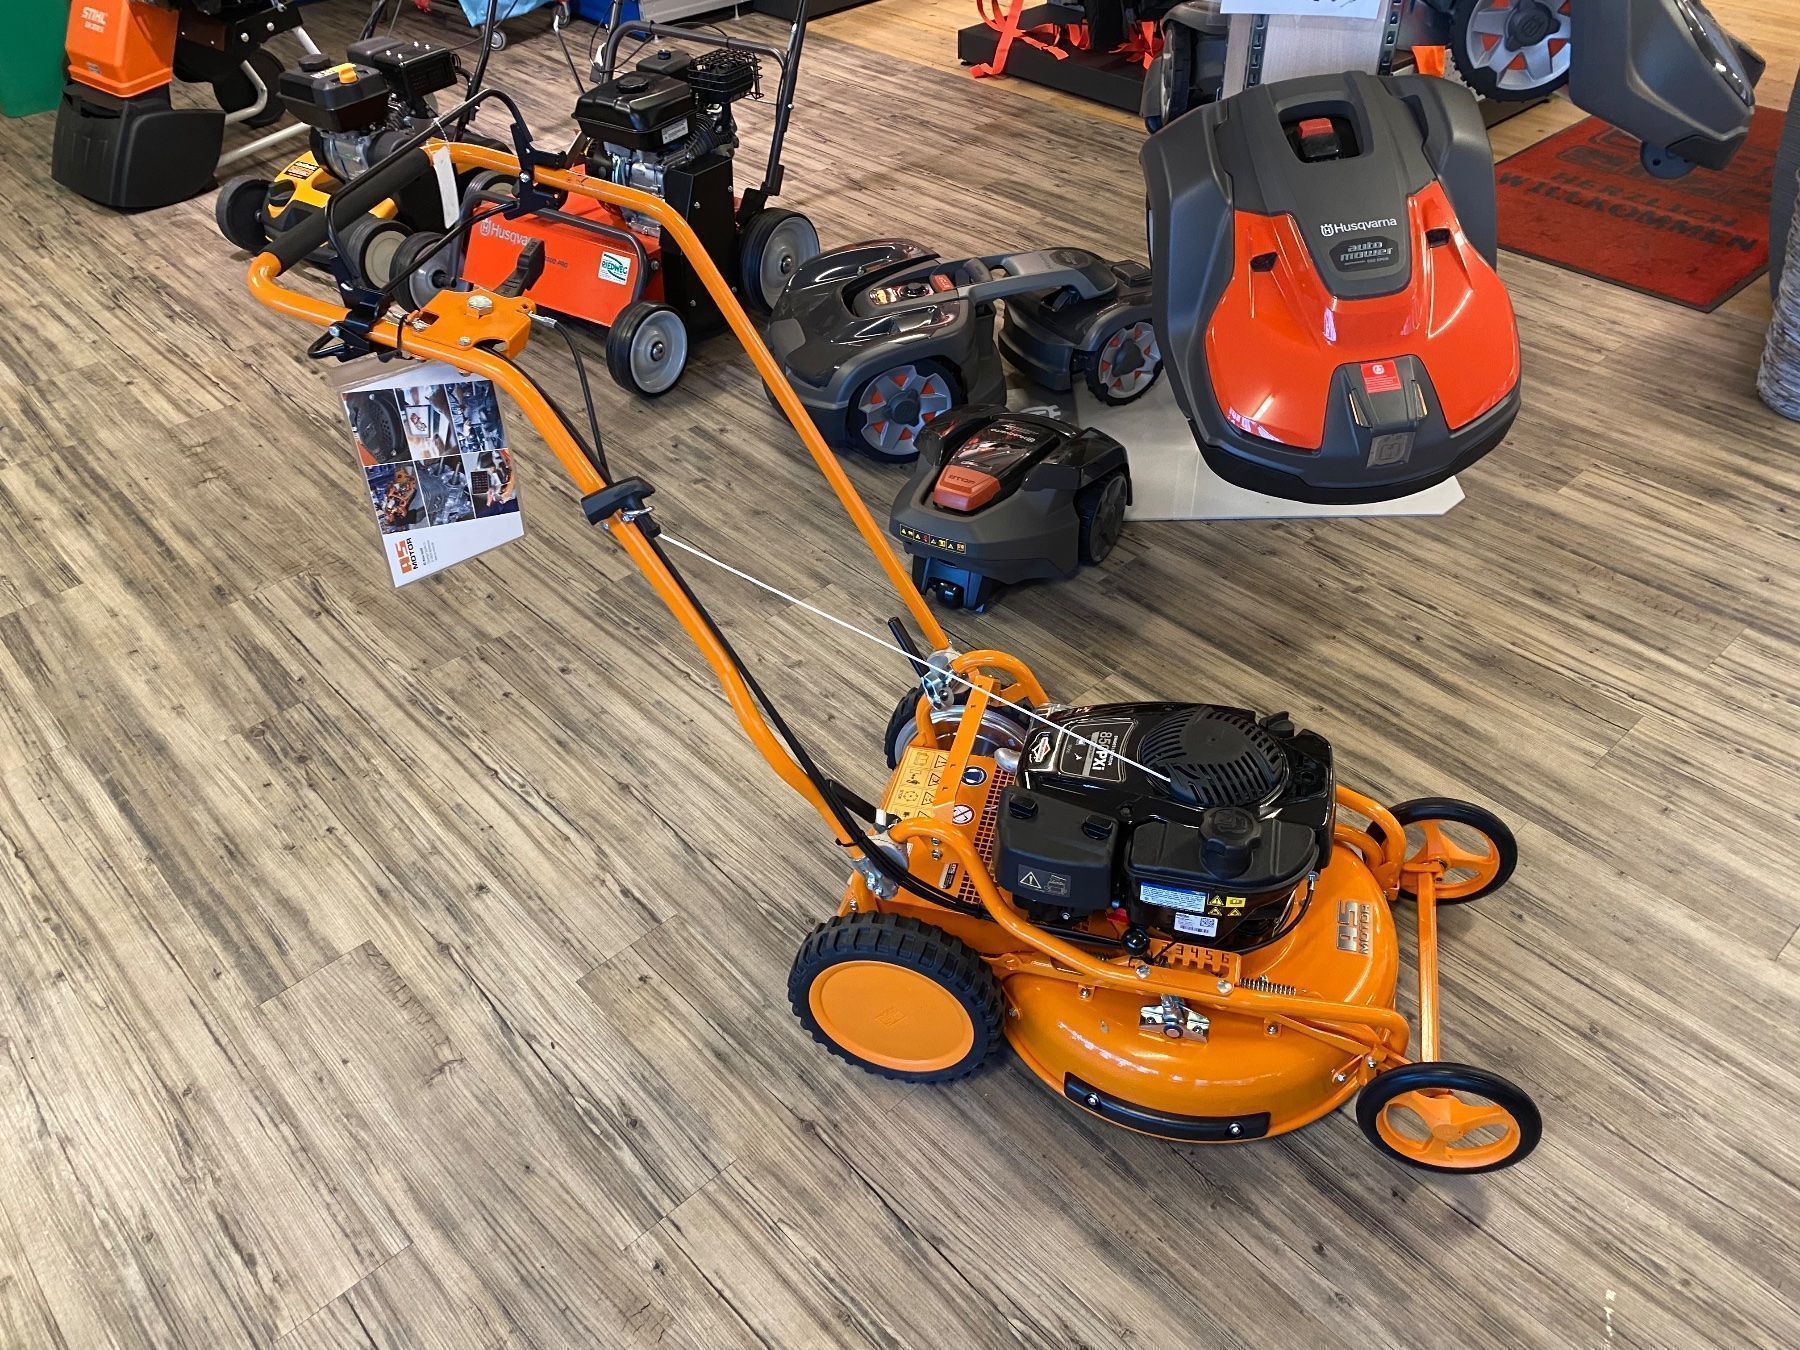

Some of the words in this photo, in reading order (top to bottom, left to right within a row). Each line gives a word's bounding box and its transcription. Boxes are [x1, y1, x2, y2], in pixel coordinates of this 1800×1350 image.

[81, 6, 108, 25] STIHL
[1499, 171, 1758, 251] WILLKOMMEN
[490, 220, 531, 246] Husqva
[1334, 218, 1397, 234] Husqvarna
[1340, 247, 1394, 262] mower
[1347, 241, 1383, 253] auto
[406, 537, 418, 570] MOTOR
[1359, 904, 1371, 955] MOTOR
[1176, 944, 1184, 956] 3
[1191, 946, 1199, 958] 4
[1205, 950, 1213, 961] 5
[1221, 953, 1230, 964] 6
